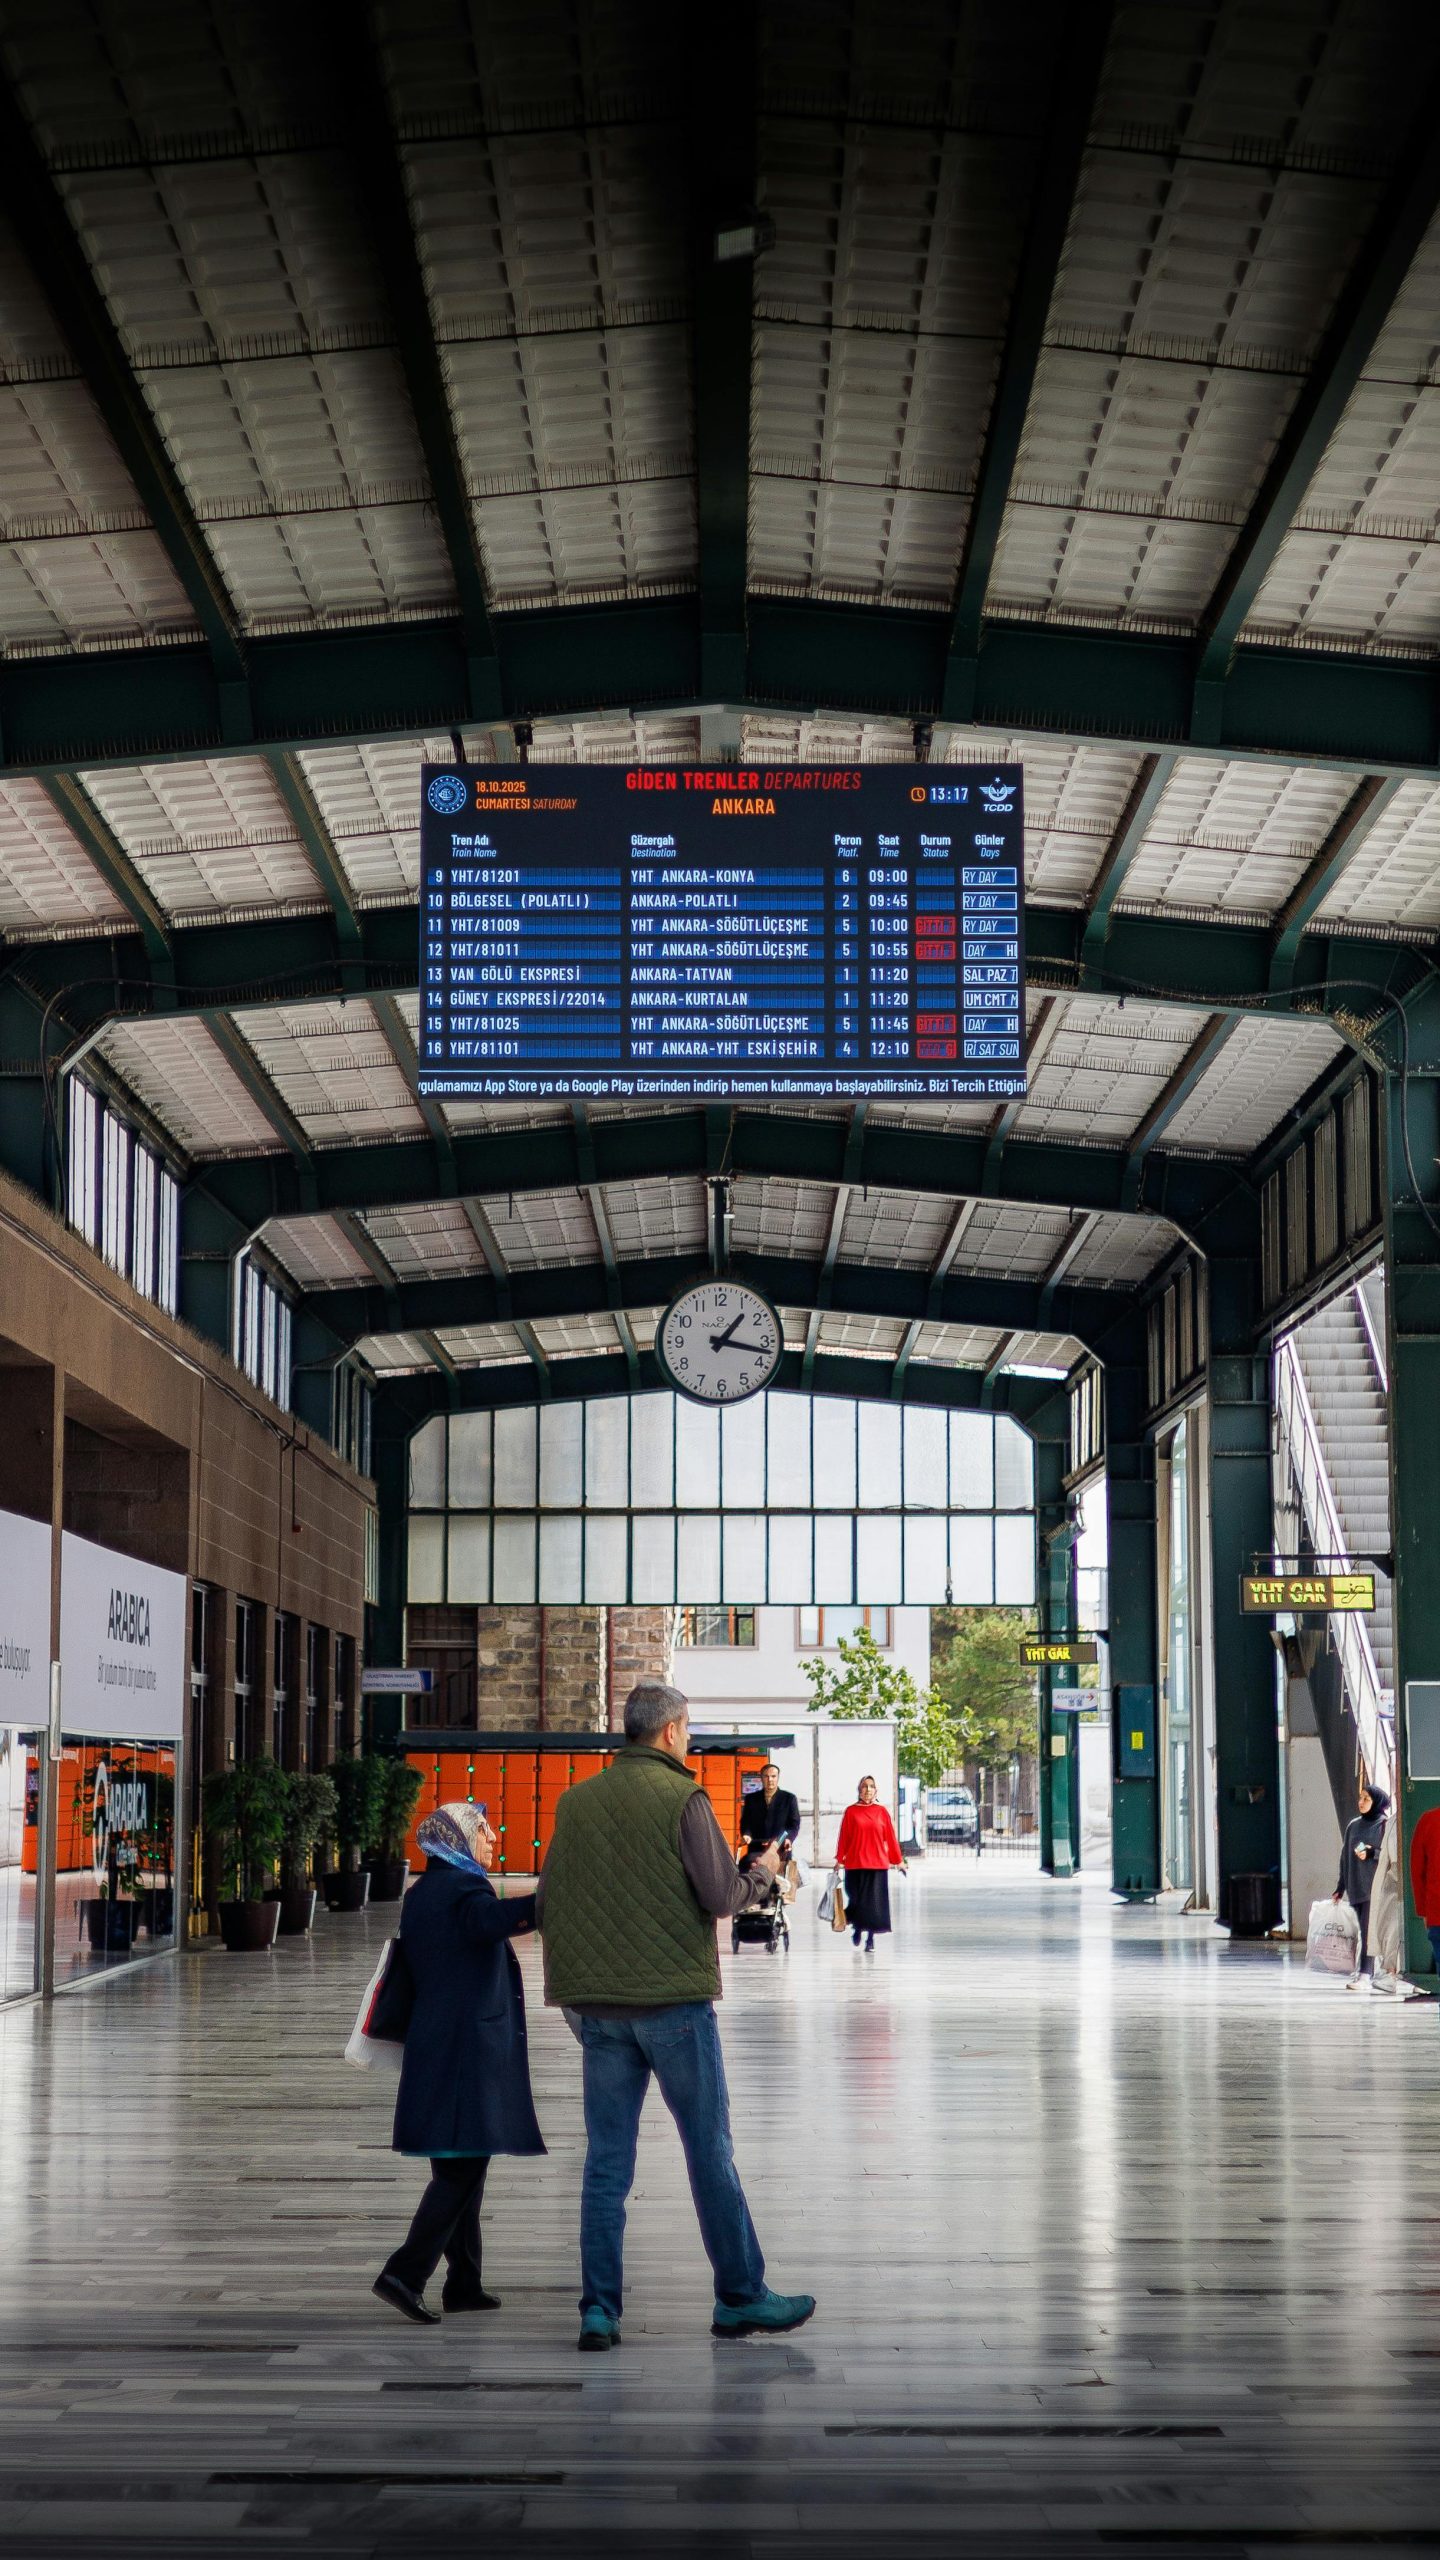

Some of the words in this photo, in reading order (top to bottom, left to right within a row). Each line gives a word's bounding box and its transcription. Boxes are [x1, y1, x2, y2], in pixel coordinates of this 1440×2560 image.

[626, 769, 676, 789] GİDEN
[683, 772, 760, 789] TRENLER
[764, 772, 862, 789] DEPARTURES
[476, 781, 526, 793] 18.10.2025
[930, 788, 968, 801] 13:17
[533, 798, 577, 810] SATURDAY
[712, 798, 776, 815] ANKARA
[983, 804, 1013, 812] TCDD
[452, 835, 472, 846] Tren
[474, 835, 489, 846] Adı
[631, 835, 674, 847] Güzergah
[834, 835, 862, 846] Peron
[878, 835, 899, 846] Saat
[920, 835, 951, 846] Durum
[975, 835, 1005, 846] Günler
[452, 848, 472, 858] Train
[474, 848, 497, 858] Name
[631, 848, 676, 858] Destination
[838, 847, 858, 858] Platf.
[879, 848, 899, 858] Time
[923, 848, 948, 858] Status
[981, 847, 1000, 859] Days
[435, 870, 443, 883] 9
[451, 870, 519, 883] YHT/81201
[631, 870, 653, 883] YHT
[661, 870, 754, 883] ANKARA-KONYA
[842, 870, 851, 883] 6
[869, 870, 908, 883] 09:00
[978, 871, 997, 883] DAY
[429, 895, 443, 908] 10
[451, 893, 512, 908] BÖLGESEL
[521, 895, 589, 910] (POLATLI)
[631, 895, 738, 908] ANKARA-POLATLI
[842, 895, 851, 908] 2
[869, 895, 908, 908] 09:45
[978, 896, 997, 908] DAY
[429, 919, 441, 932] 11
[451, 919, 520, 932] YHT/81009
[631, 919, 653, 932] YHT
[661, 917, 808, 935] ANKARA-SÖĞÜTLÜÇEŞME
[842, 919, 851, 932] 5
[869, 919, 908, 932] 10:00
[978, 920, 997, 932] DAY
[428, 944, 442, 957] 12
[451, 943, 519, 957] YHT/81011
[631, 943, 653, 957] YHT
[661, 942, 808, 960] ANKARA-SÖĞÜTLÜÇEŞME
[842, 944, 851, 957] 5
[869, 943, 908, 957] 10:55
[968, 945, 987, 957] DAY
[428, 968, 442, 981] 13
[451, 968, 474, 981] VAN
[481, 966, 512, 981] GÖLÜ
[520, 966, 581, 981] EKSPRESİ
[631, 968, 732, 981] ANKARA-TATVAN
[842, 968, 851, 981] 1
[869, 968, 908, 981] 11:20
[964, 969, 983, 982] SAL
[987, 969, 1007, 982] PAZ
[427, 993, 442, 1006] 14
[450, 991, 489, 1006] GÜNEY
[497, 991, 605, 1006] EKSPRESİ/22014
[631, 992, 748, 1006] ANKARA-KURTALAN
[842, 993, 851, 1006] 1
[869, 992, 908, 1006] 11:20
[984, 994, 1006, 1006] CMT
[427, 1018, 441, 1031] 15
[450, 1017, 520, 1031] YHT/81025
[631, 1017, 653, 1031] YHT
[661, 1015, 808, 1033] ANKARA-SÖĞÜTLÜÇEŞME
[842, 1018, 851, 1031] 5
[869, 1017, 908, 1031] 11:45
[968, 1018, 988, 1031] DAY
[427, 1042, 441, 1055] 16
[450, 1042, 519, 1055] YHT/81101
[631, 1042, 653, 1055] YHT
[661, 1042, 739, 1055] ANKARA-YHT
[748, 1040, 817, 1058] ESKİŞEHİR
[842, 1042, 851, 1055] 4
[869, 1042, 908, 1055] 12:10
[979, 1043, 997, 1055] SAT
[484, 1080, 506, 1094] App
[508, 1080, 538, 1092] Store
[540, 1083, 553, 1094] ya
[555, 1080, 569, 1092] da
[572, 1080, 609, 1094] Google
[611, 1080, 633, 1094] Play
[636, 1080, 691, 1092] üzerinden
[693, 1080, 728, 1094] indirip
[731, 1080, 768, 1092] hemen
[771, 1080, 833, 1094] kullanmaya
[835, 1080, 927, 1094] başlayabilirsiniz.
[929, 1080, 949, 1092] Bizi
[951, 1080, 987, 1092] Tercih
[990, 1080, 1027, 1094] Ettiğini
[695, 1300, 704, 1312] 11
[714, 1294, 727, 1306] 12
[679, 1316, 691, 1328] 10
[753, 1313, 761, 1326] 2
[675, 1336, 684, 1348] 9
[760, 1336, 769, 1347] 3
[680, 1358, 688, 1370] 8
[754, 1356, 764, 1368] 4
[697, 1375, 705, 1386] 7
[717, 1379, 726, 1391] 6
[740, 1373, 748, 1385] 5
[1250, 1582, 1285, 1603] YHT
[1290, 1582, 1326, 1603] GAR
[108, 1588, 150, 1647] ARABICA
[1048, 1647, 1070, 1660] GAR
[109, 1783, 147, 1832] ARABICA
